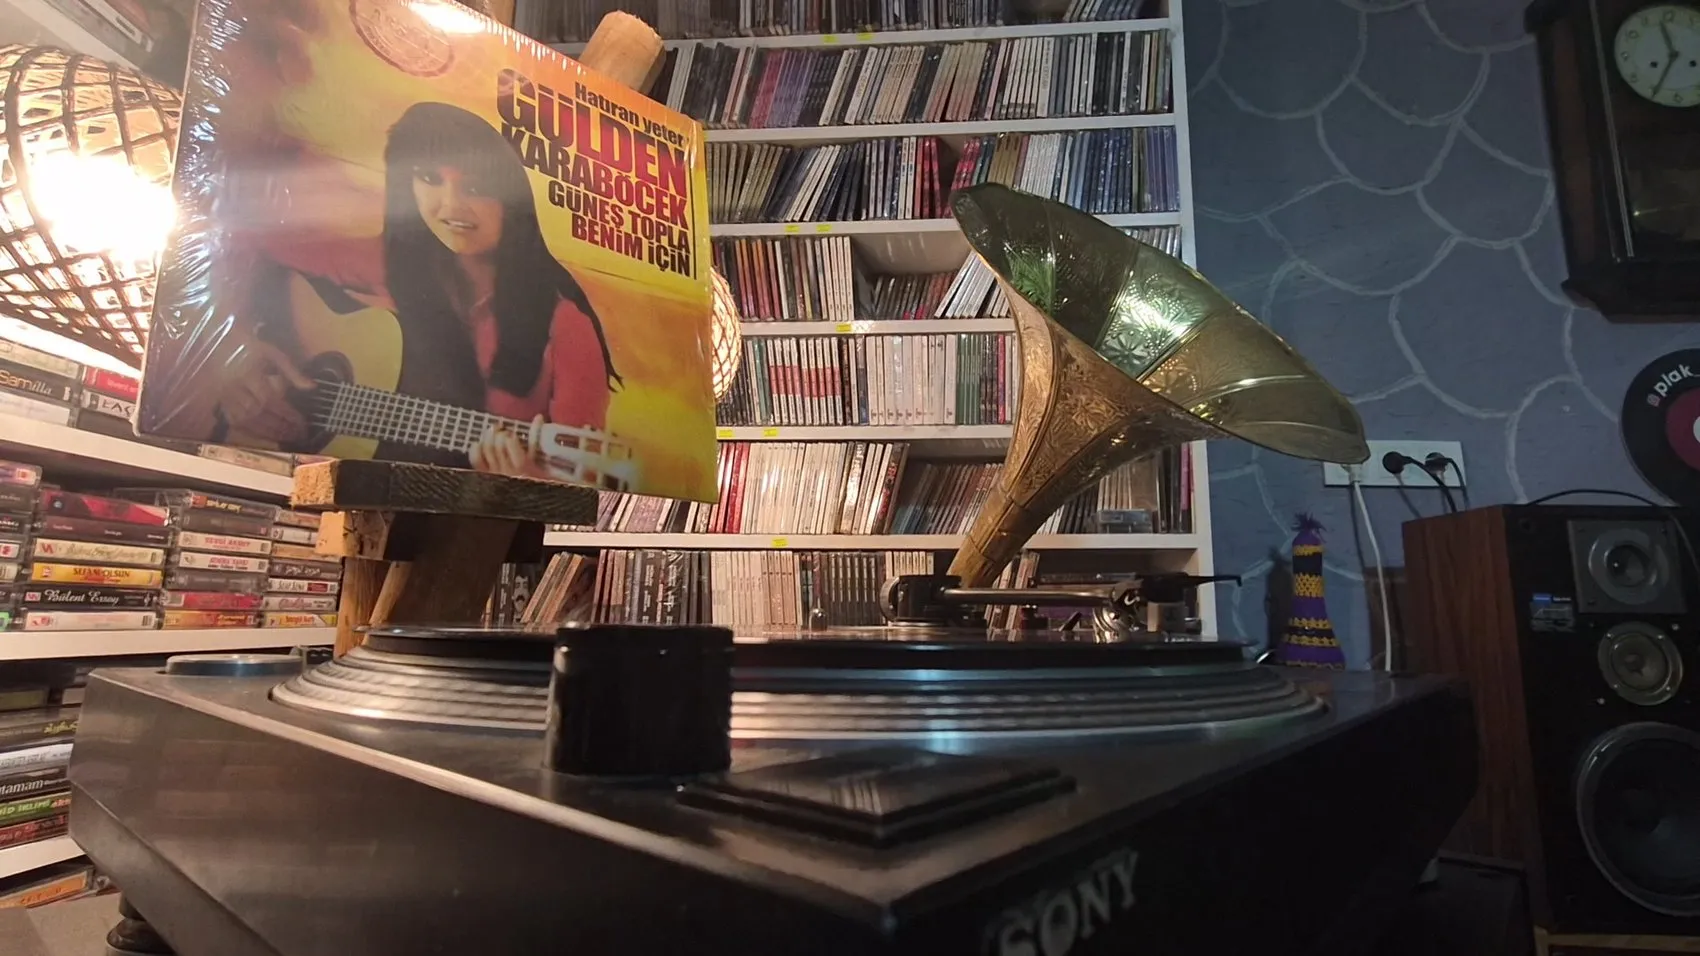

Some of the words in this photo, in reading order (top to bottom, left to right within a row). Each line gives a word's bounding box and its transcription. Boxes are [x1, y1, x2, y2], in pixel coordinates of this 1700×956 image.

[497, 68, 688, 200] GÜLDEN
[574, 82, 640, 128] Hatıran
[642, 117, 684, 148] yeter
[502, 121, 689, 230] KARABÖCEK
[548, 180, 625, 228] GÜNEŞ
[628, 209, 691, 254] TOPLA
[44, 589, 86, 603] Bülent
